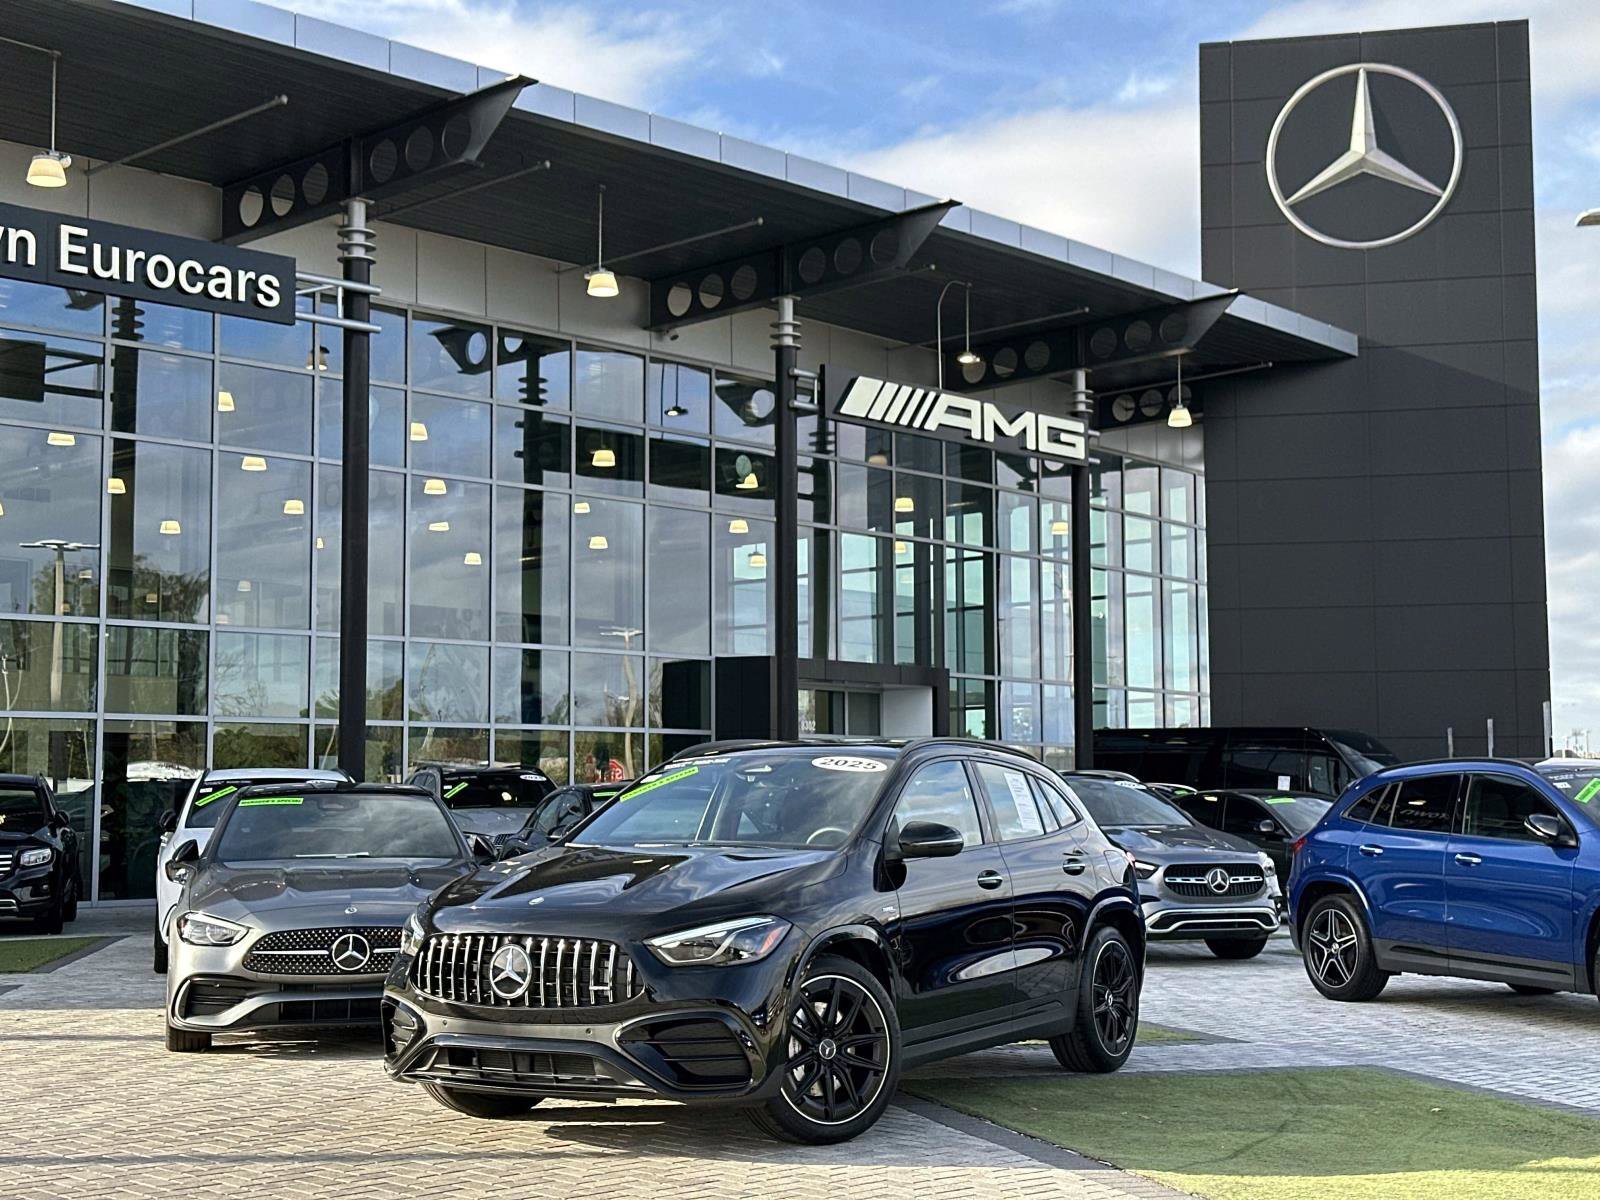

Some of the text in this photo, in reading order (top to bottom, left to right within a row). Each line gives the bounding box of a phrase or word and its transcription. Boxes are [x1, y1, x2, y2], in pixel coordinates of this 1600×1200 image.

[0, 223, 281, 308] n Eurocars
[923, 393, 1086, 460] AMG
[820, 758, 880, 770] 2025
